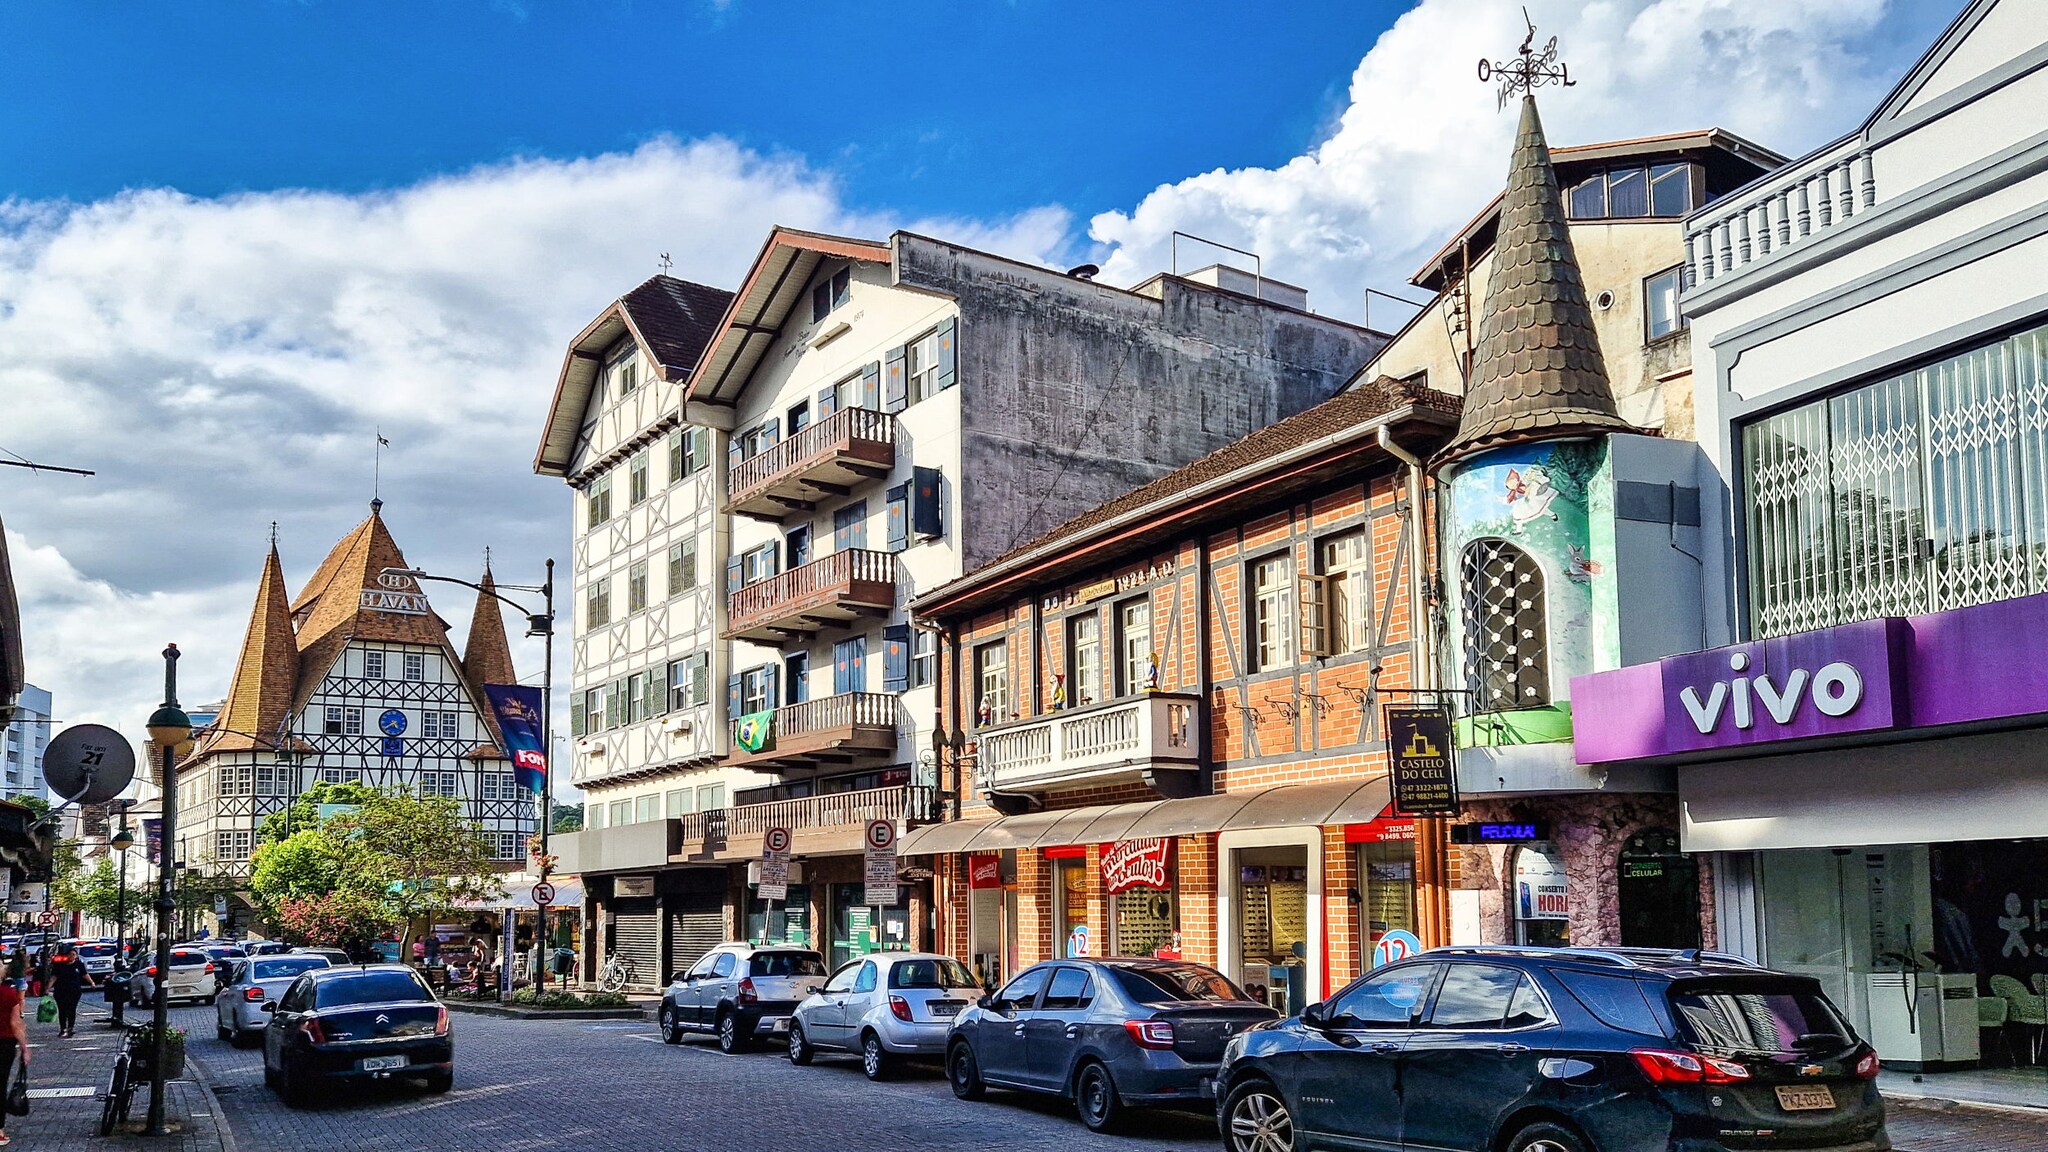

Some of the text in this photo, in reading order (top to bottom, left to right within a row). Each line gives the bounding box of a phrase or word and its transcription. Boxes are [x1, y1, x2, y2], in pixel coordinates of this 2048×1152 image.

[360, 592, 427, 612] HAVAN
[1679, 652, 1863, 734] vivo
[81, 751, 104, 765] 21
[1400, 759, 1445, 769] CASTELO
[1402, 769, 1445, 780] DO CELL
[1407, 784, 1414, 792] 47
[773, 833, 783, 847] E
[875, 826, 886, 843] E
[1631, 869, 1663, 877] CELULAR
[1538, 885, 1564, 893] CONSERTO
[1071, 933, 1087, 955] 12
[1380, 938, 1406, 965] 12
[1302, 1096, 1335, 1104] EQUINOX
